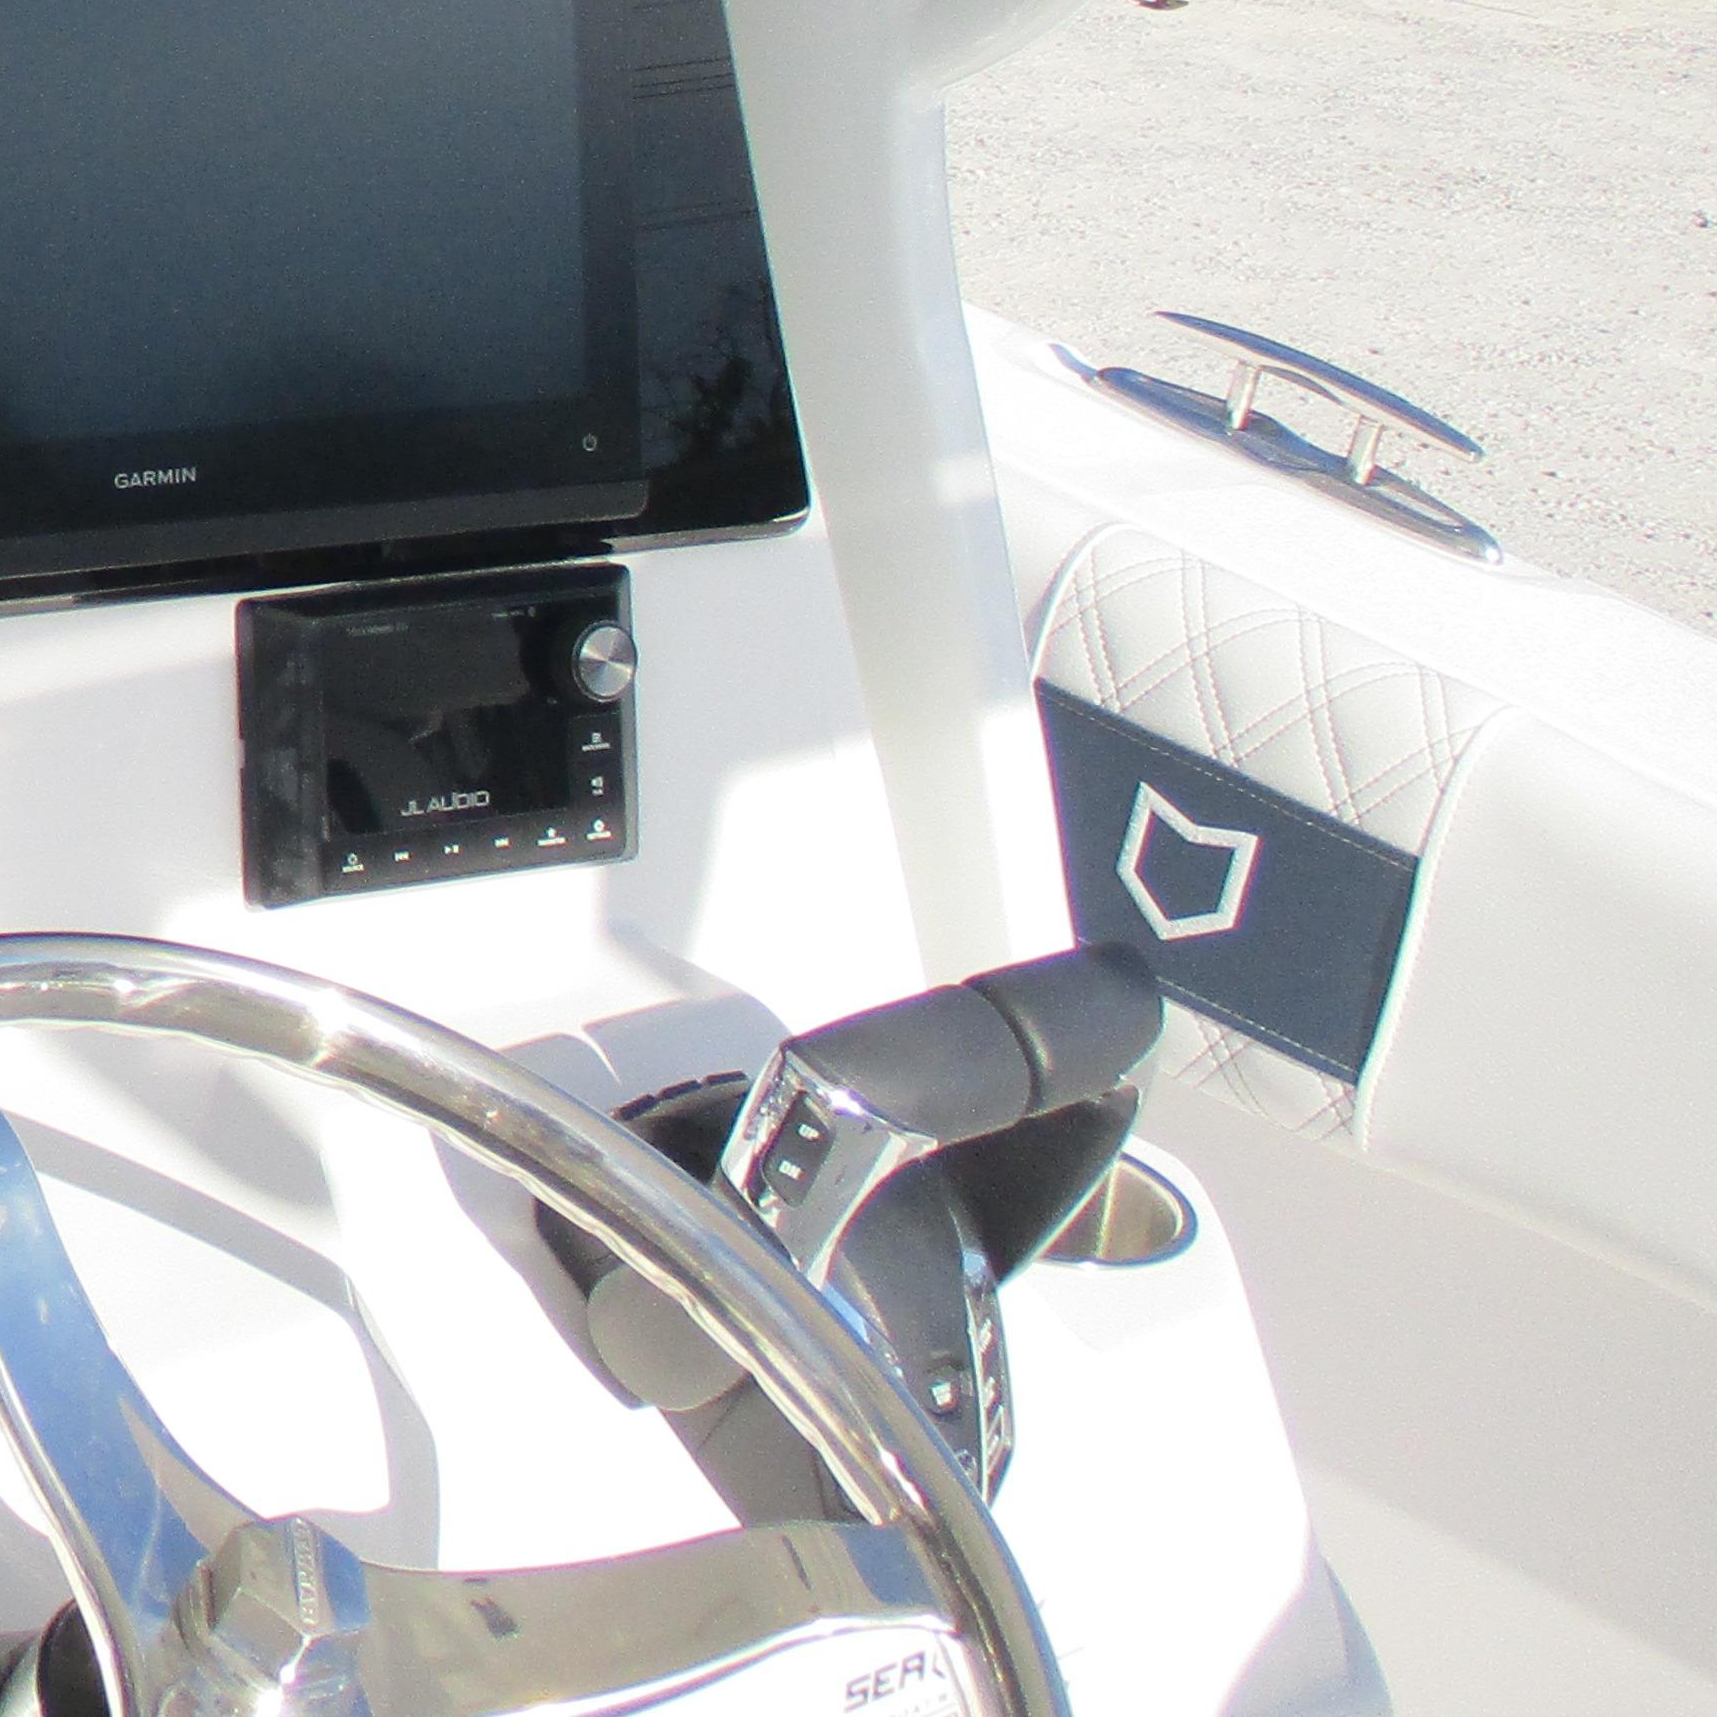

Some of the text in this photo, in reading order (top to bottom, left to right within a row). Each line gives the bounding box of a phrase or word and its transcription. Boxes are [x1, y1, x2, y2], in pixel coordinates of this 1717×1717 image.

[114, 466, 197, 490] GARMIN
[401, 790, 490, 816] JL AUDIO
[844, 1650, 925, 1713] SEA
